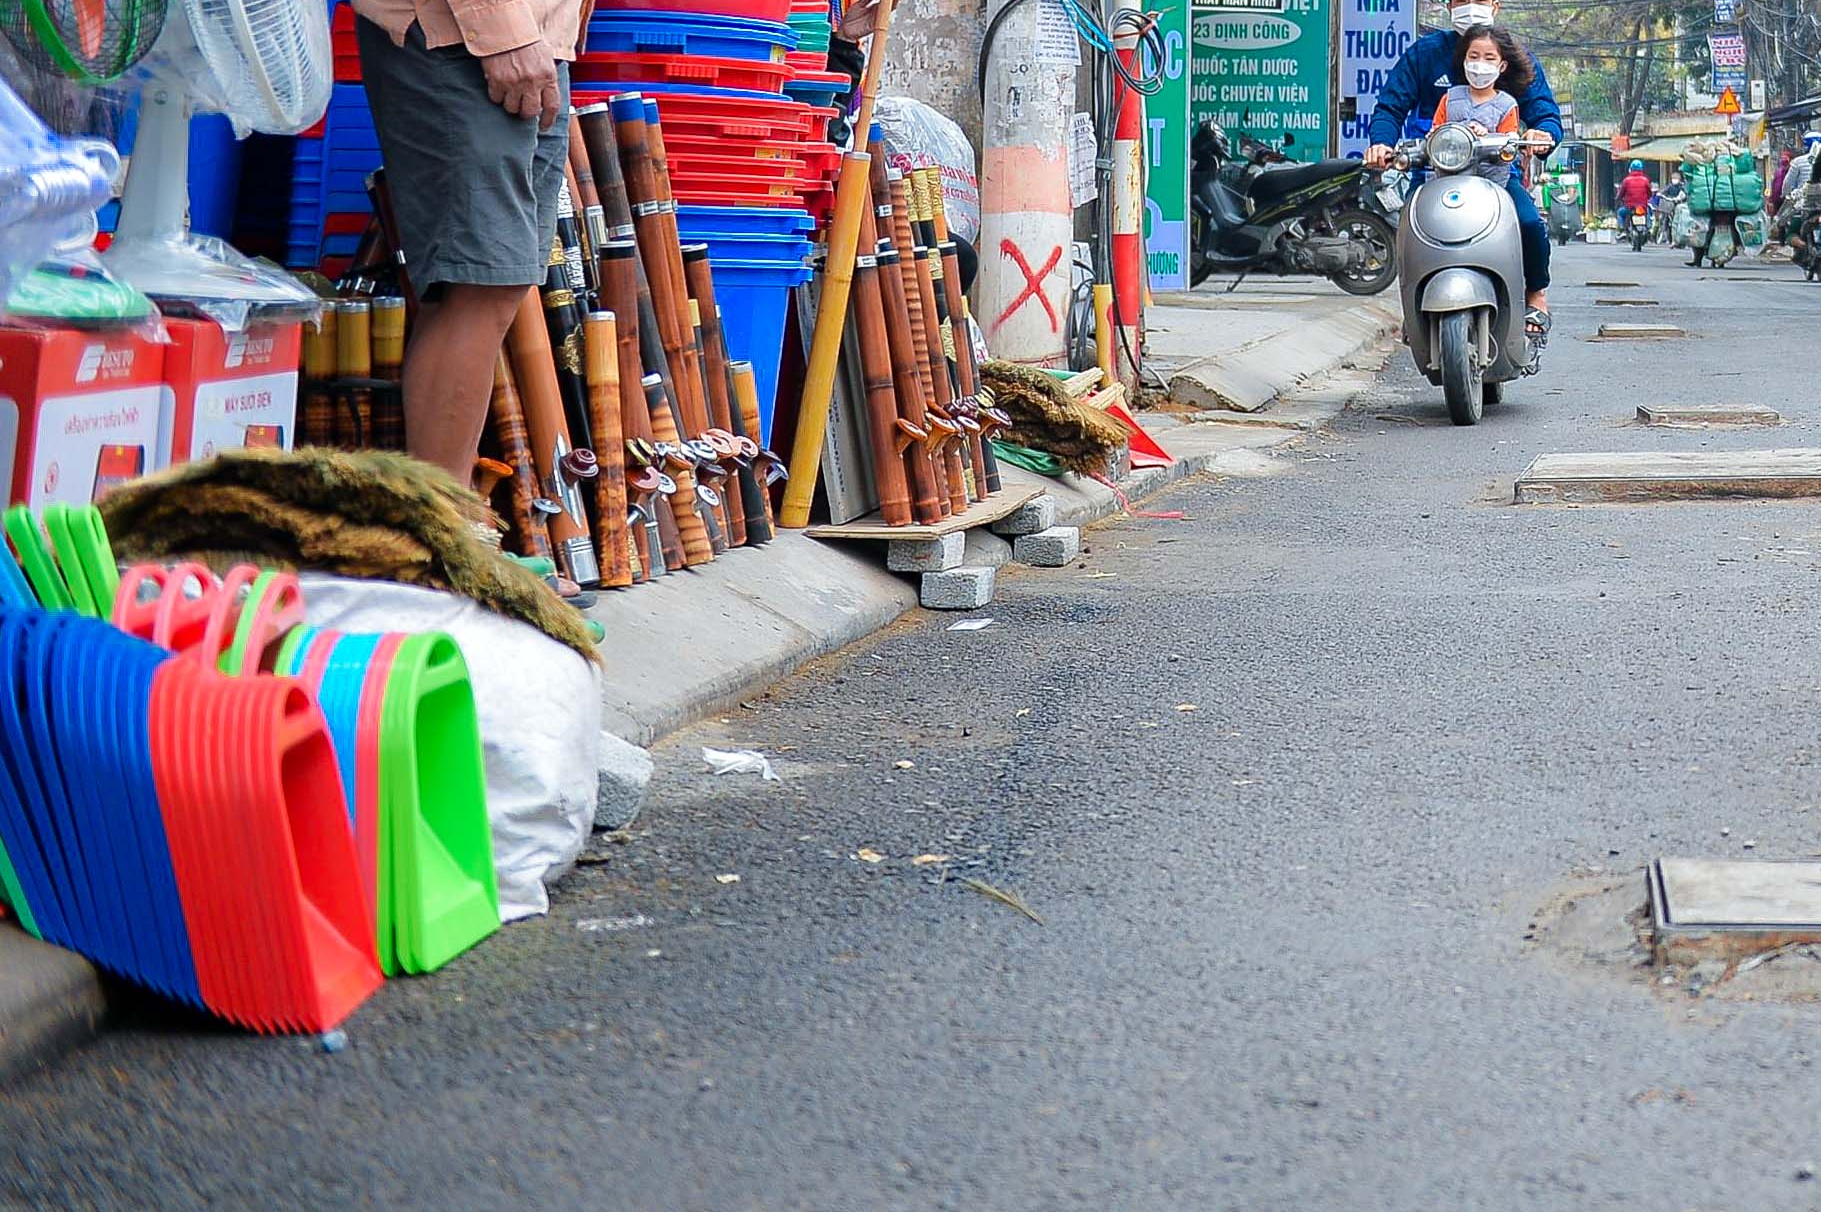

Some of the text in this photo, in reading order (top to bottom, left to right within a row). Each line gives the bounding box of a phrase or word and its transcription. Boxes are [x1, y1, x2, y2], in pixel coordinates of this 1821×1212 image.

[1215, 23, 1248, 42] ĐỊNH
[1253, 20, 1290, 39] CÔNG
[1344, 21, 1410, 59] THUỐC
[1192, 52, 1298, 80] HUỐC TÂN DƯỢC
[1221, 82, 1274, 102] CHUYÊN
[1278, 83, 1309, 106] VIỆN
[1283, 110, 1321, 129] NĂNG
